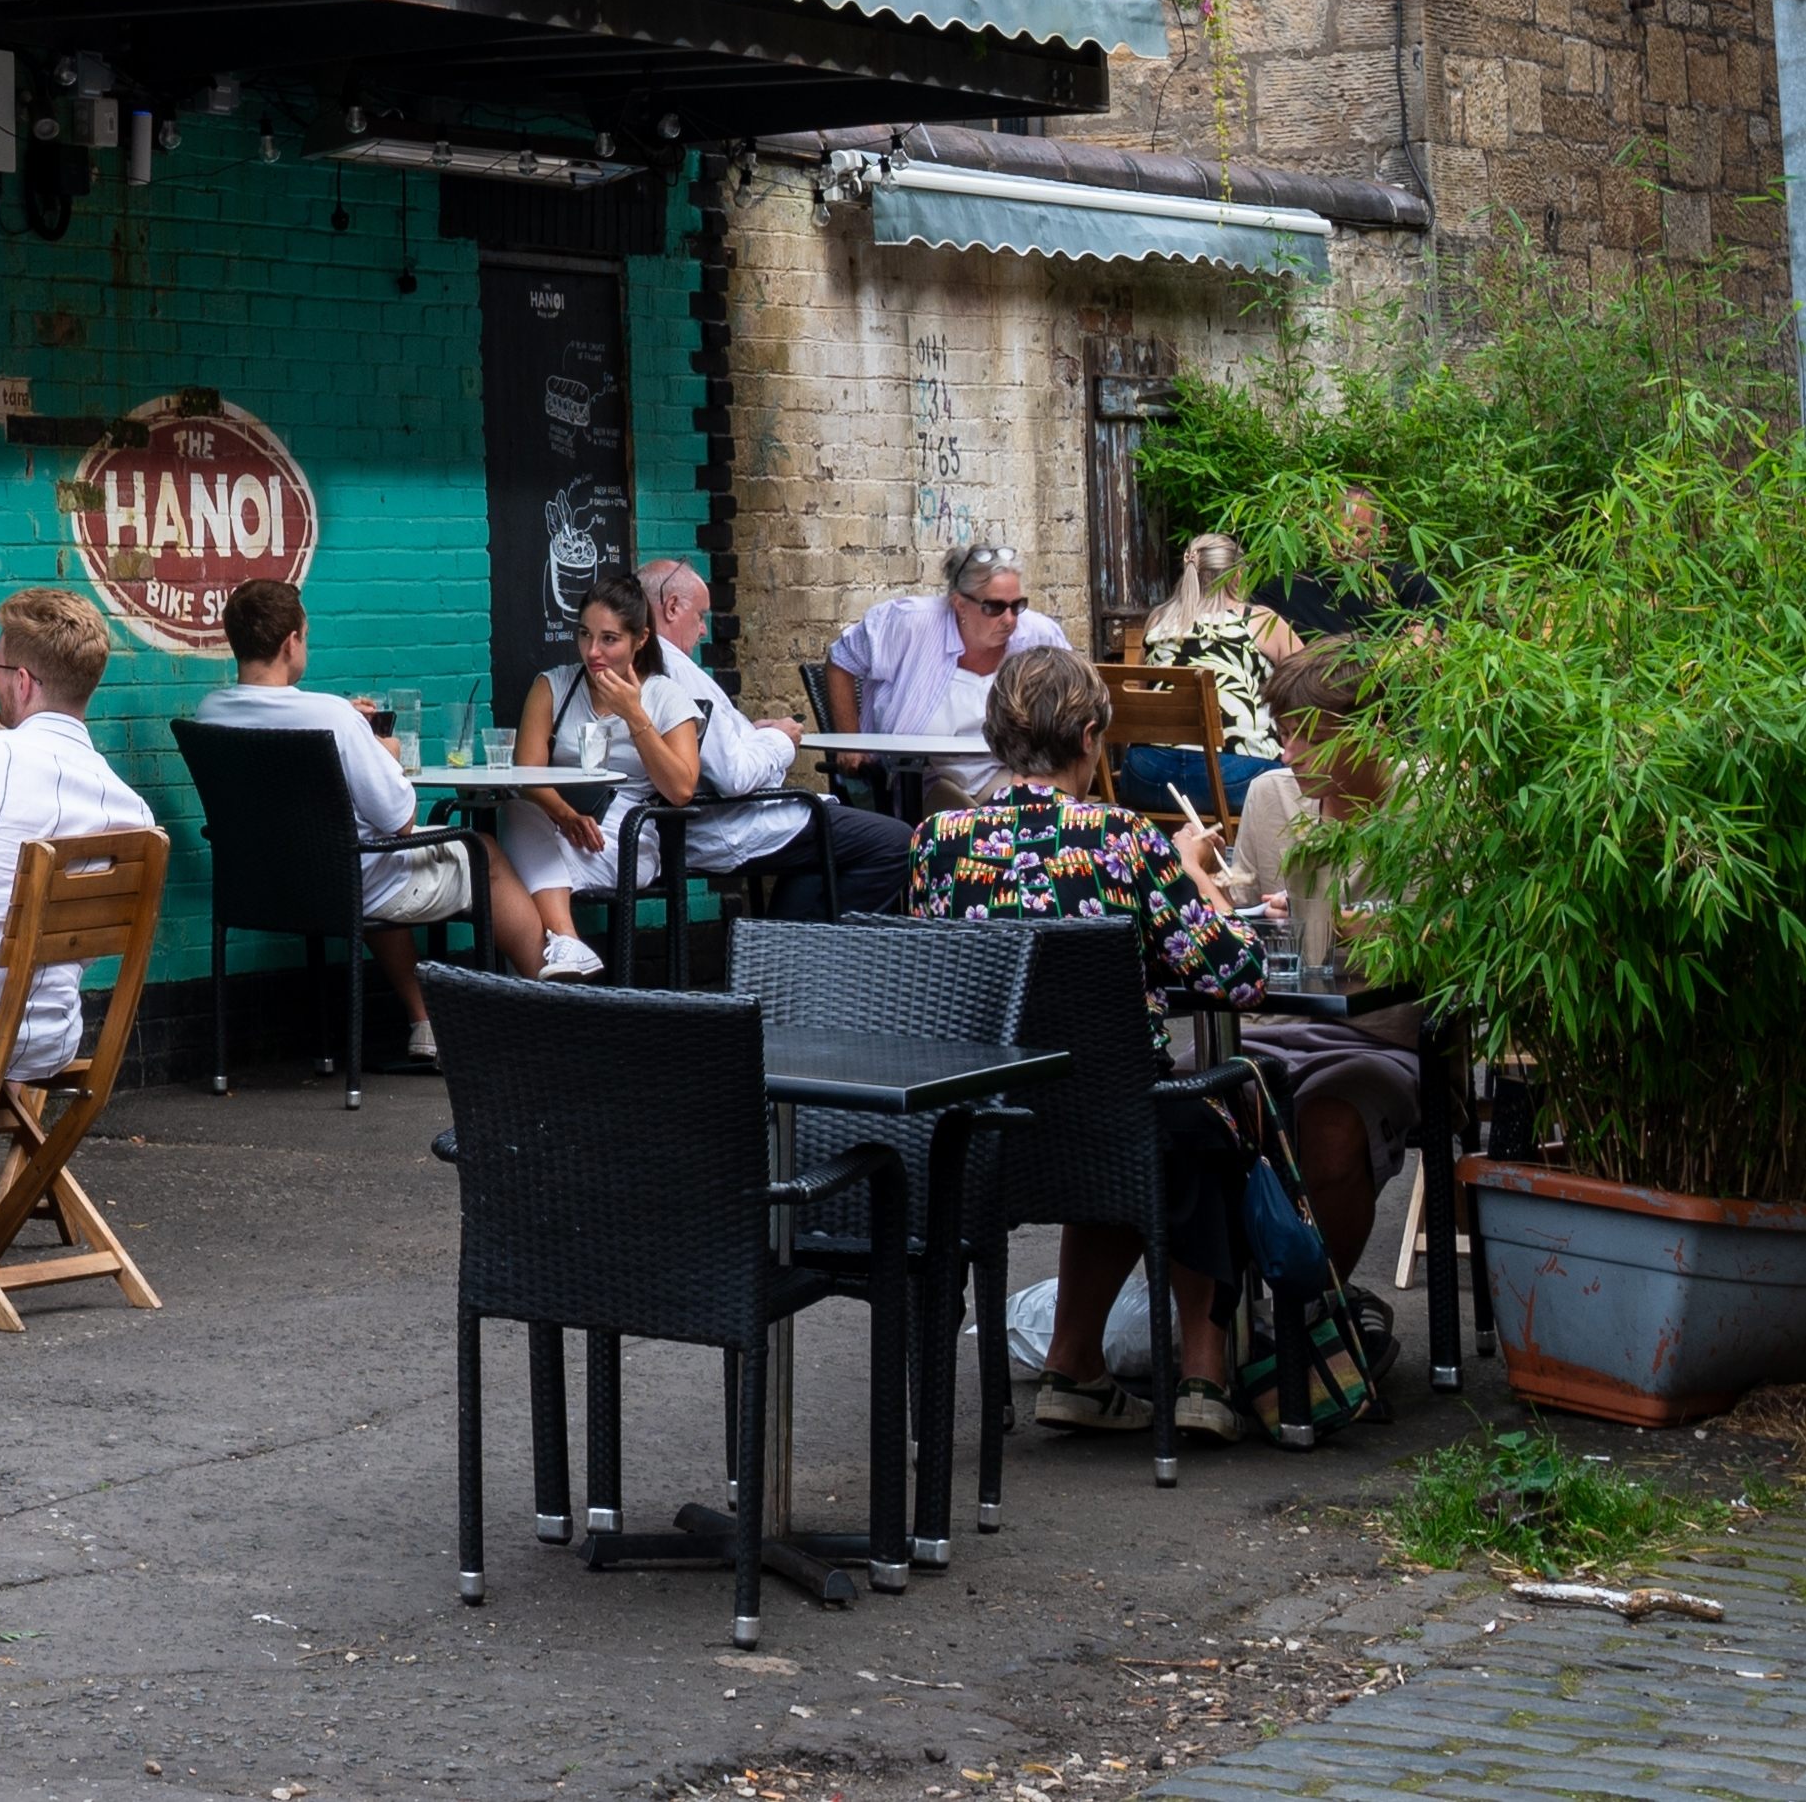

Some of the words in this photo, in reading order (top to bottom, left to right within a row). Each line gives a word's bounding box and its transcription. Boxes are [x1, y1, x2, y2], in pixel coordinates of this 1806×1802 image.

[530, 291, 565, 310] HANOI
[172, 429, 216, 460] THE
[105, 470, 285, 558] HANOI
[146, 578, 193, 623] BIKE
